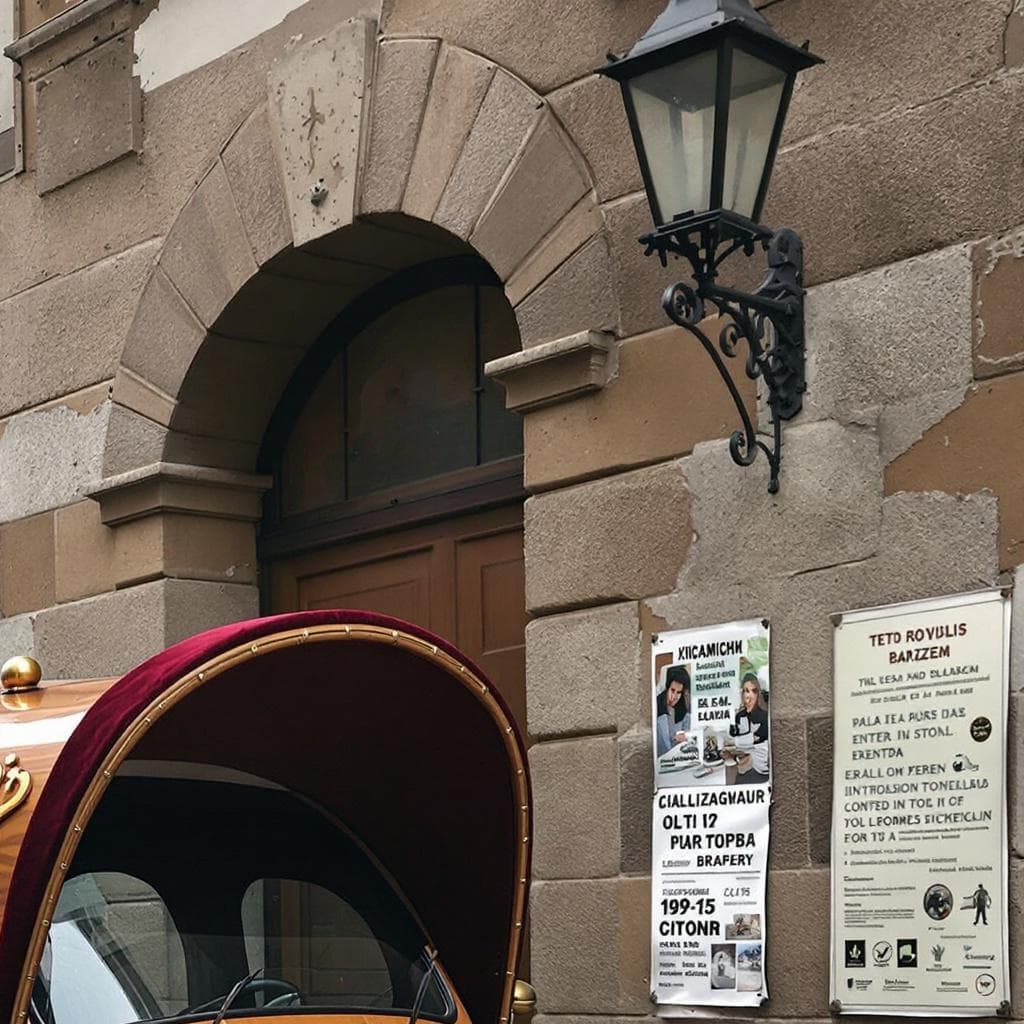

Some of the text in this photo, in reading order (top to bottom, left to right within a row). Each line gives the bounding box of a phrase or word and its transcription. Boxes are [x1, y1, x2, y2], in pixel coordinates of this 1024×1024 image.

[705, 832, 756, 849] TOPBA
[696, 853, 754, 867] BRAFERY
[660, 898, 716, 915] 199-15
[659, 920, 720, 936] CITONR
